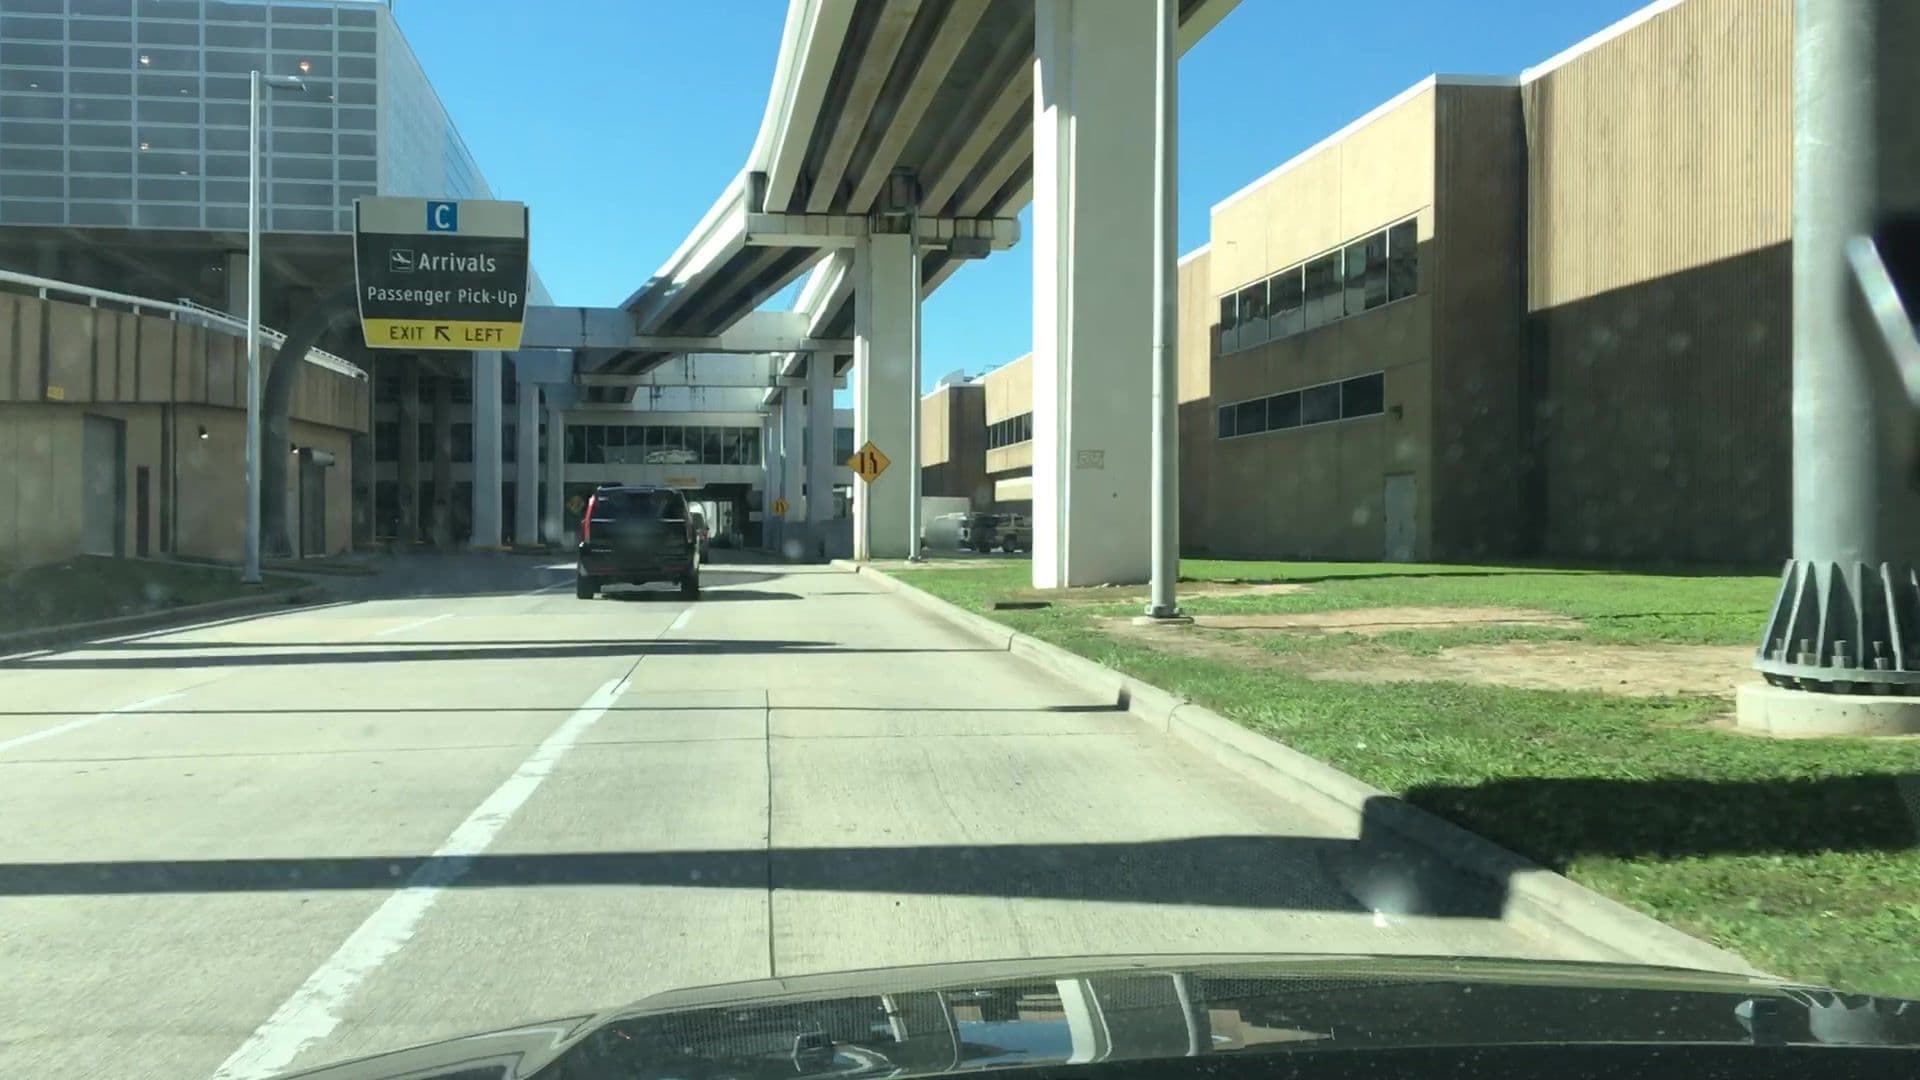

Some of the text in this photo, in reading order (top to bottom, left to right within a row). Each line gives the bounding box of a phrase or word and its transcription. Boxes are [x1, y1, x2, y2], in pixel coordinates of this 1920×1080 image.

[434, 204, 450, 228] C
[418, 253, 497, 272] Arrivals
[367, 286, 518, 307] Passenger Pick-Up
[389, 326, 504, 342] EXIT LEFT
